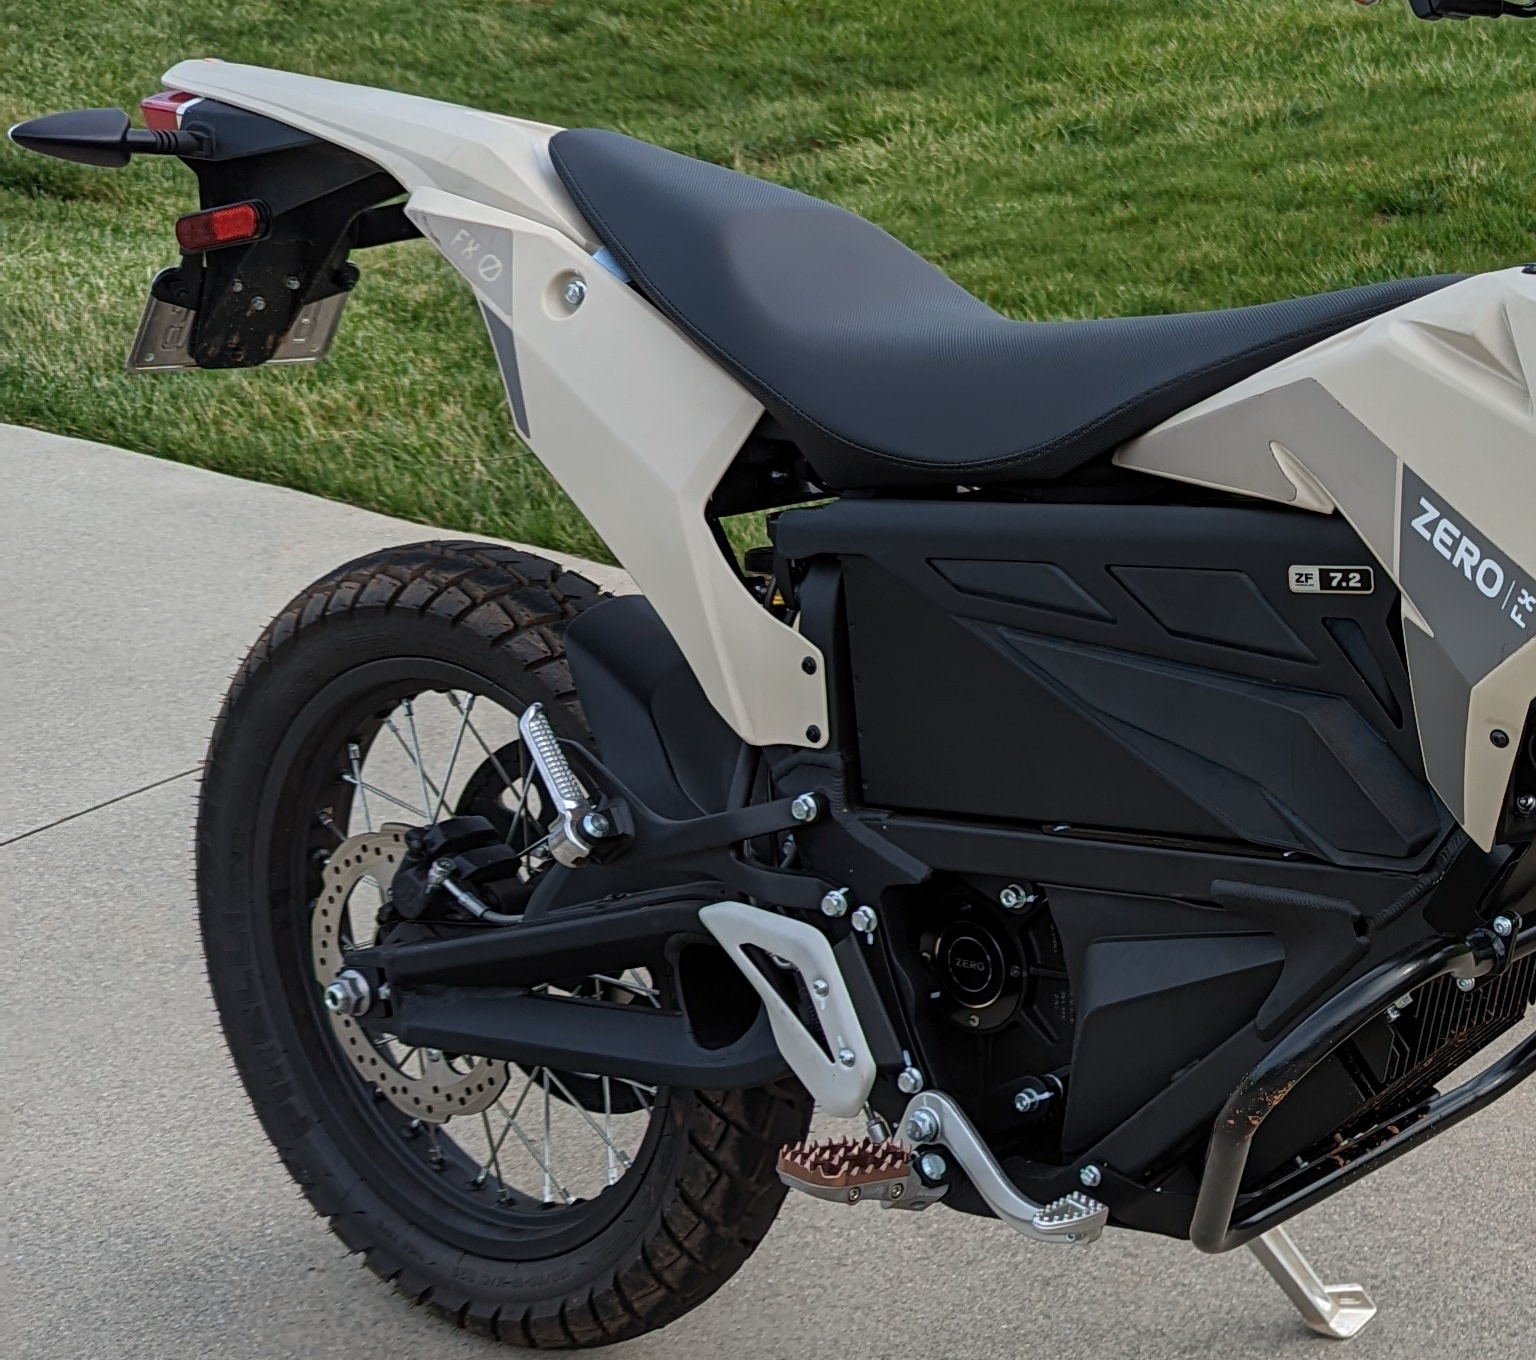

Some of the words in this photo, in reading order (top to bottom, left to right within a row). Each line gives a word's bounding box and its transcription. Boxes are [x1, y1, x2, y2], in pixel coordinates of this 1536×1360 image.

[450, 228, 480, 260] FX
[1410, 496, 1504, 599] ZERO
[1294, 572, 1314, 584] ZF
[1329, 572, 1362, 588] 7.2
[954, 957, 986, 972] ZERO
